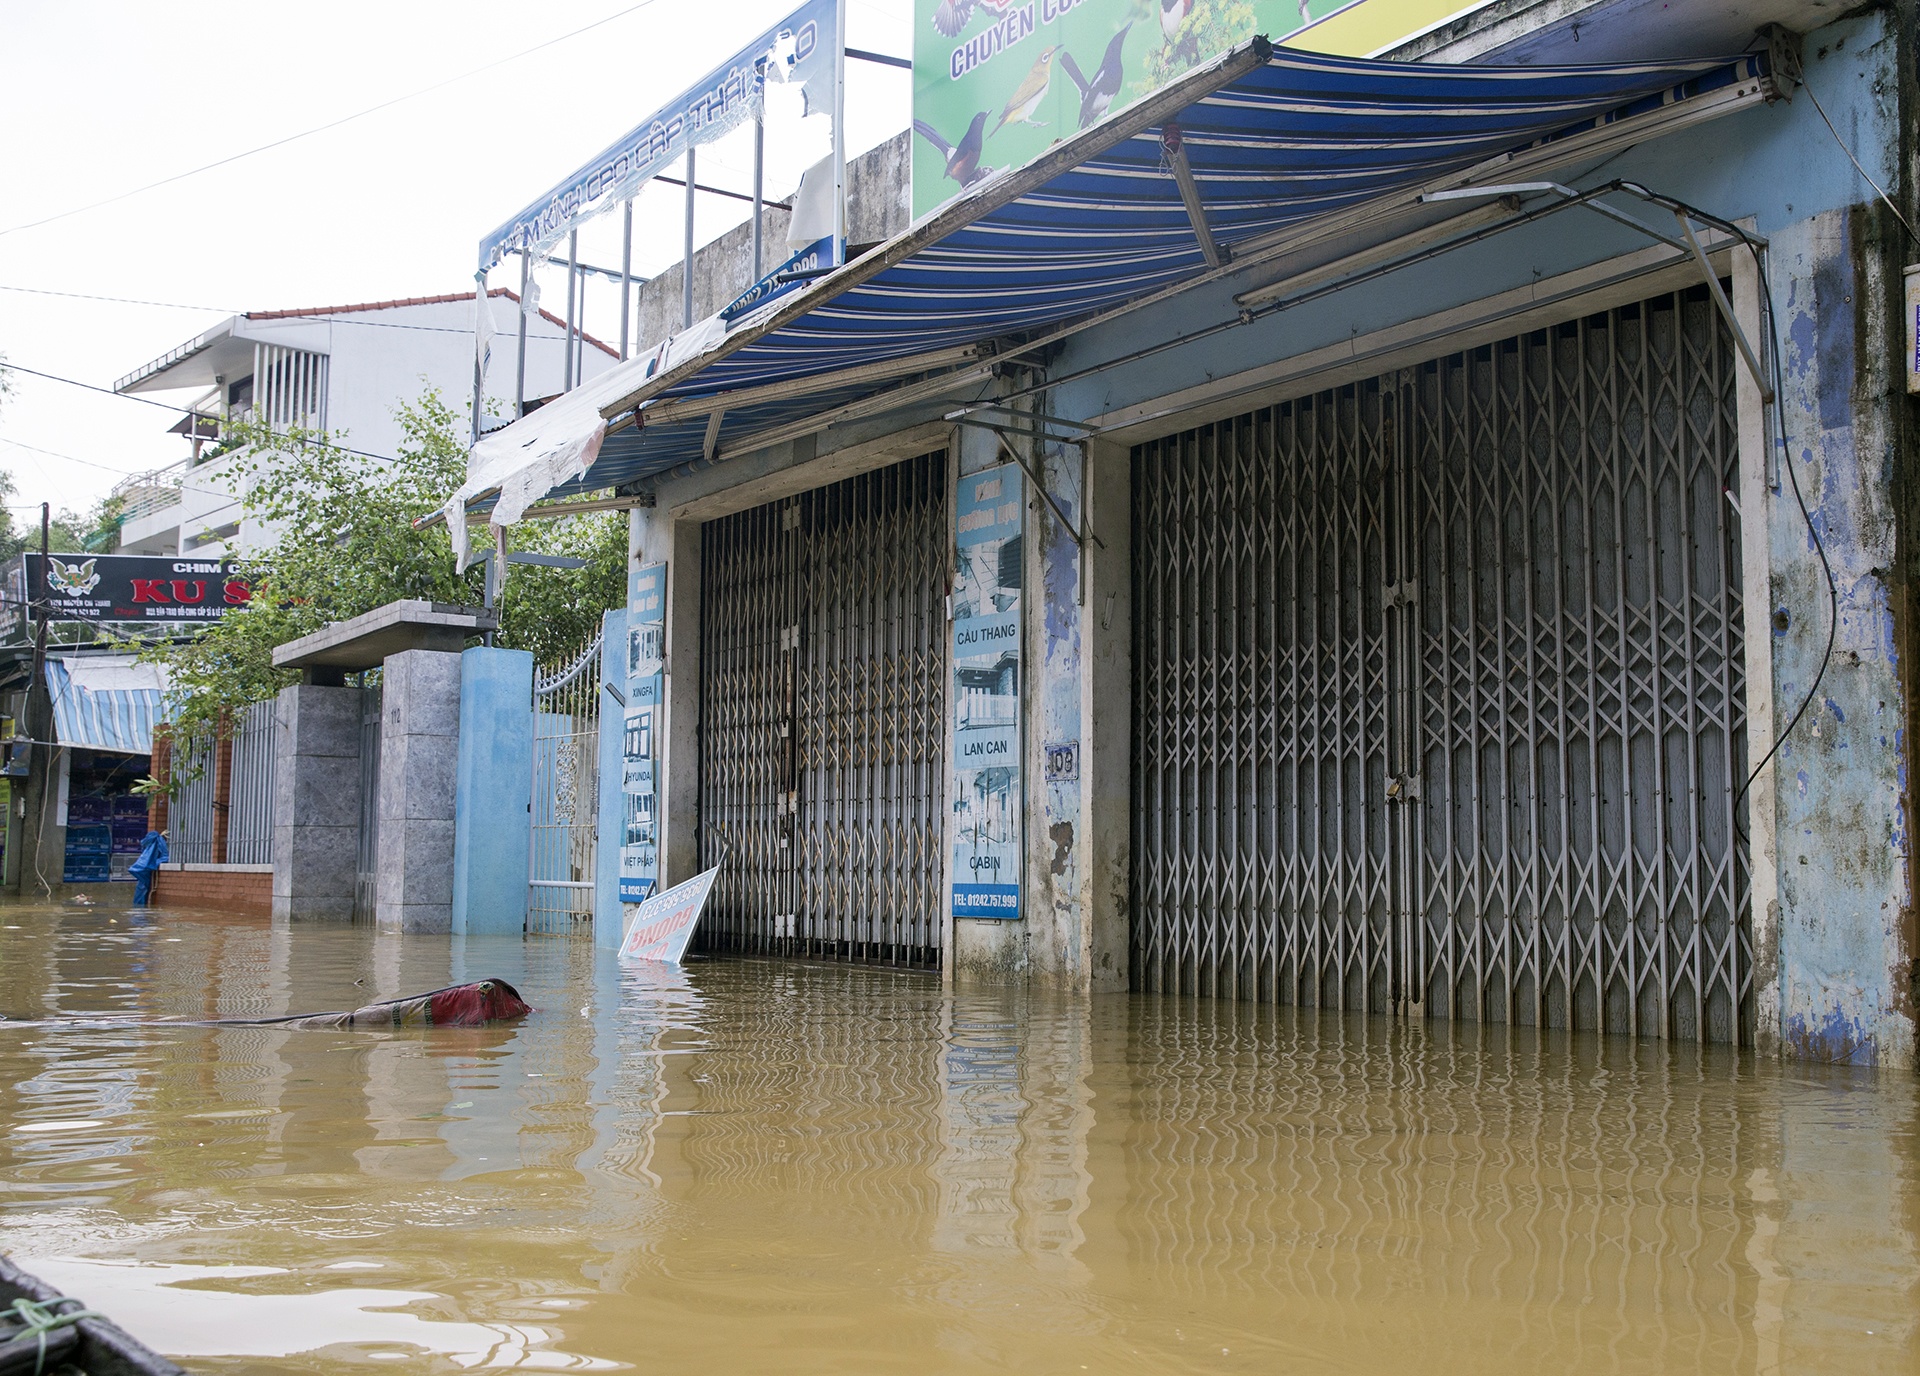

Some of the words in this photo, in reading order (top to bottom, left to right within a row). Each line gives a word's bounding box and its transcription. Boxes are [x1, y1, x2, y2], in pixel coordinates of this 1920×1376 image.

[951, 4, 1034, 79] CHUYÊN
[172, 563, 222, 574] CHIM
[130, 579, 207, 604] KU
[980, 623, 1016, 641] THANG
[632, 686, 653, 698] XINGFA
[964, 742, 984, 756] LAN
[986, 740, 1008, 754] CAN
[969, 856, 1001, 870] CABIN
[953, 893, 967, 906] TEL:
